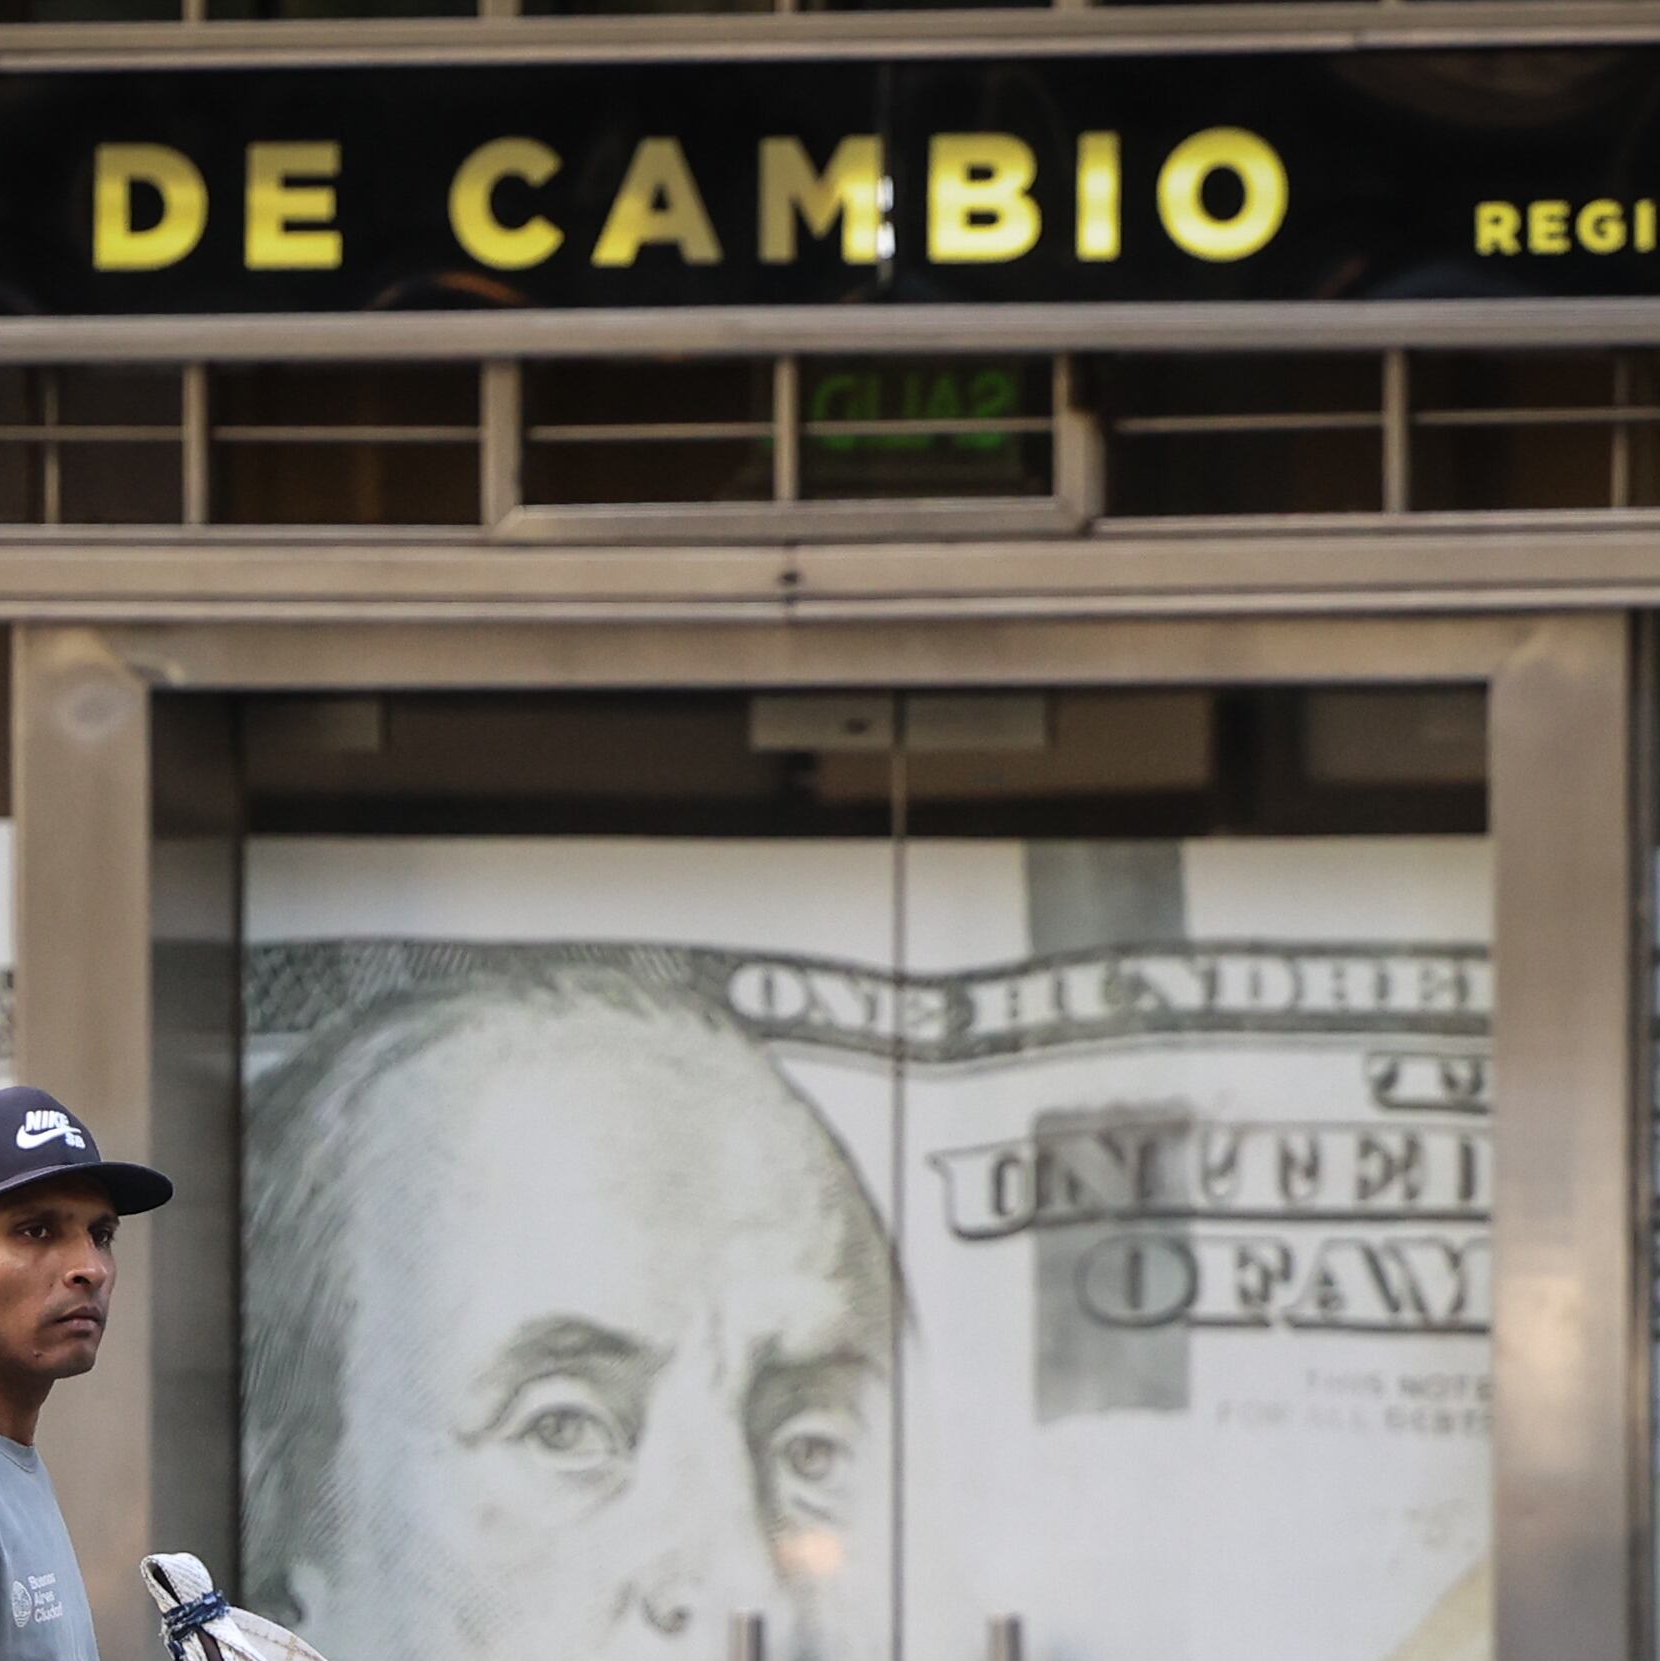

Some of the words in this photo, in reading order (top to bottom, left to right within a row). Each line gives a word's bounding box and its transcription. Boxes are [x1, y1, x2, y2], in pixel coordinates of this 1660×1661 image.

[92, 142, 343, 271] DE
[448, 126, 1290, 270] CAMBIO
[729, 962, 943, 1040] ONE
[967, 952, 1492, 1036] HUNDRE
[25, 1109, 70, 1133] NIKE
[65, 1132, 86, 1149] SB
